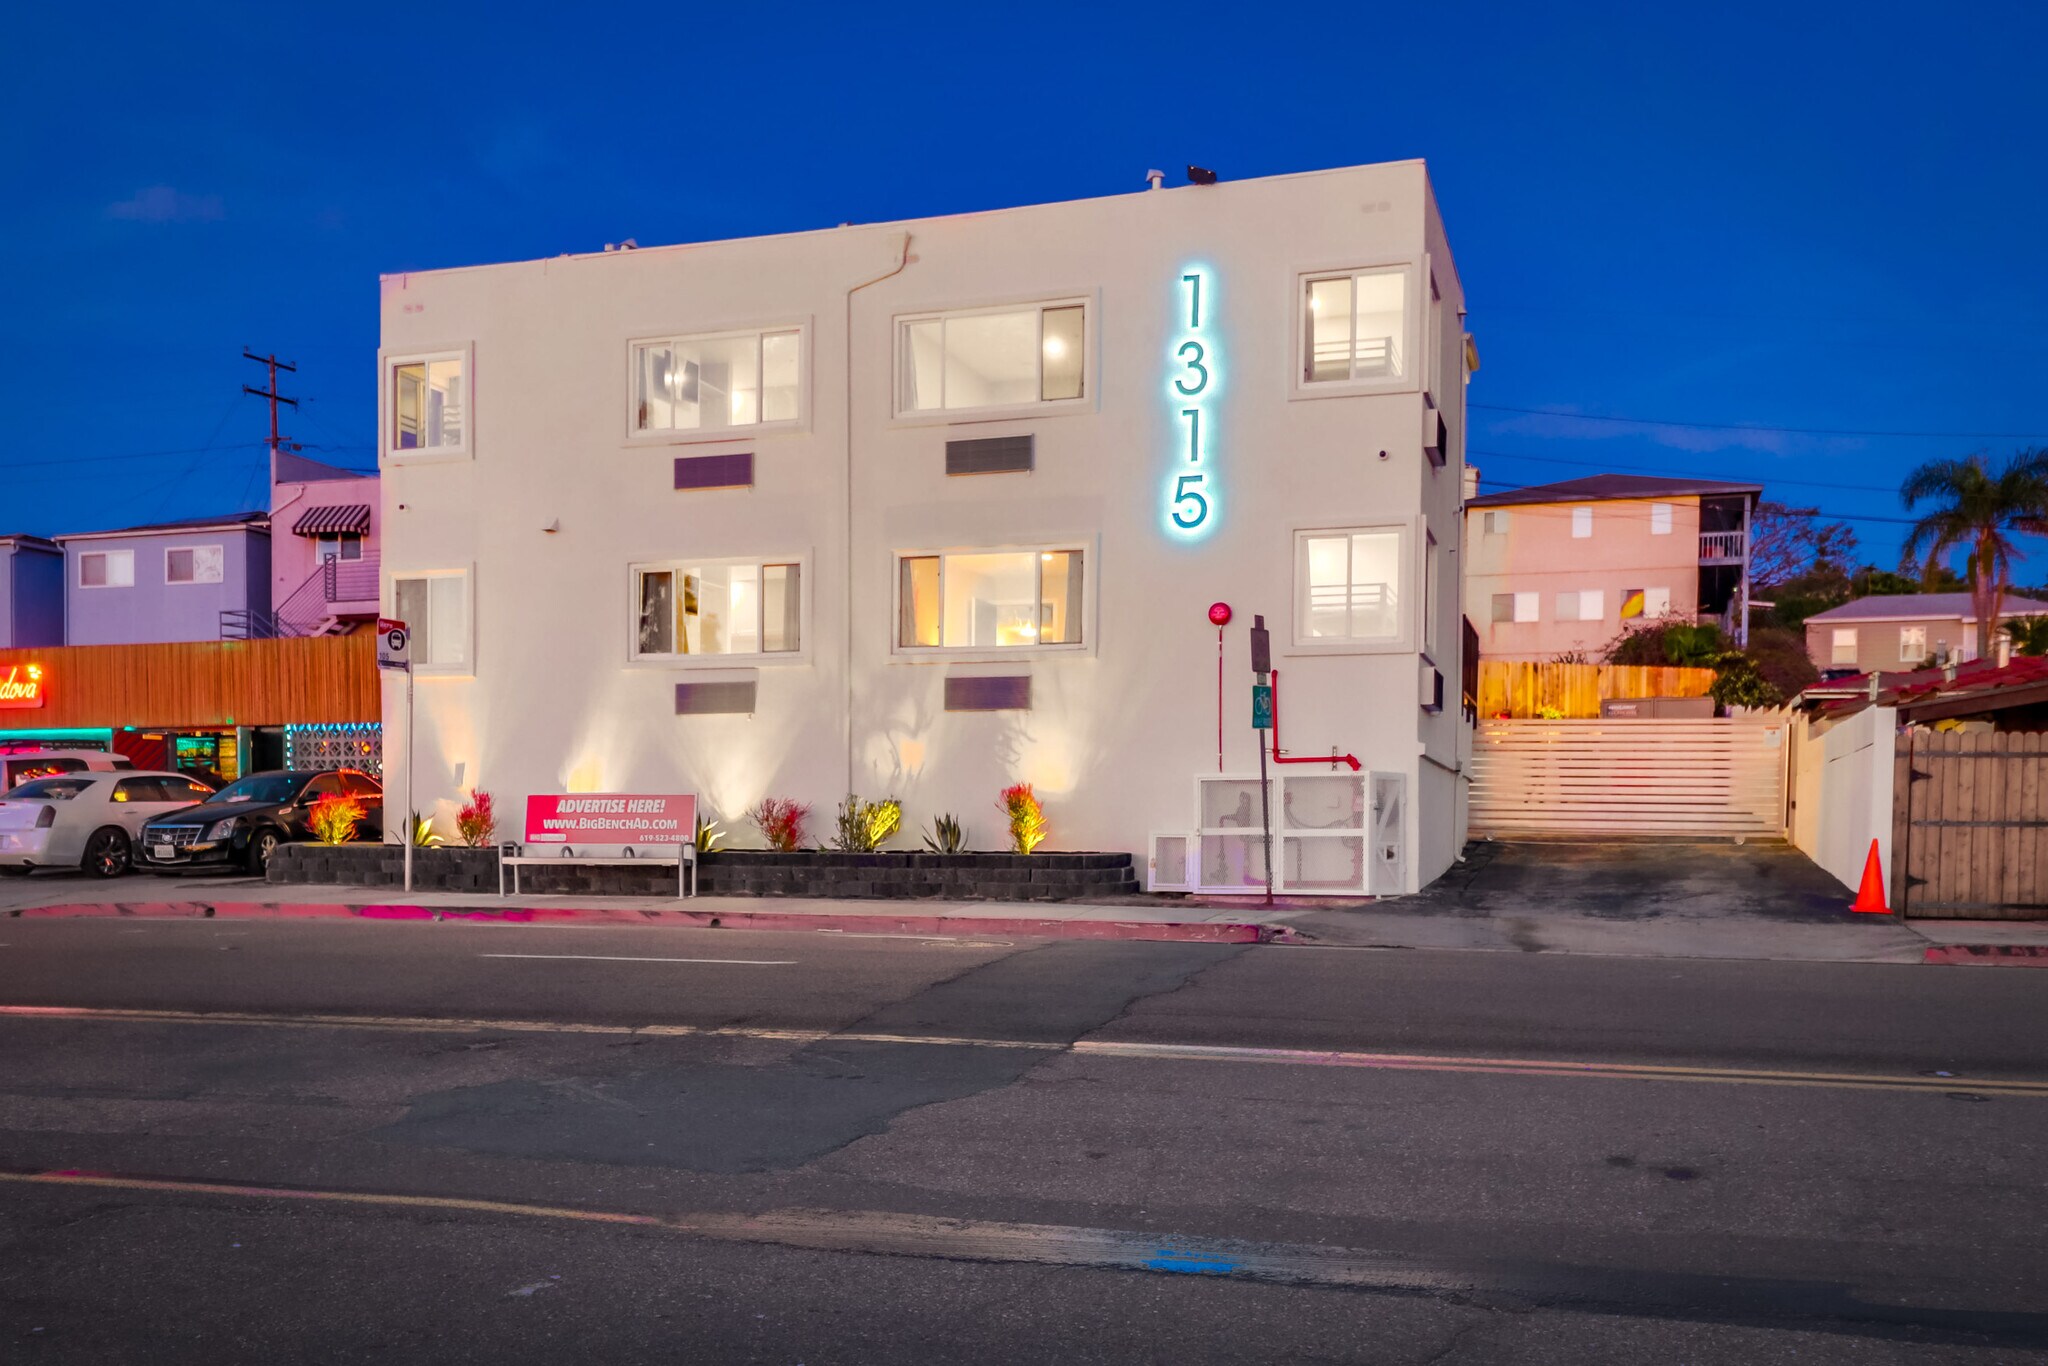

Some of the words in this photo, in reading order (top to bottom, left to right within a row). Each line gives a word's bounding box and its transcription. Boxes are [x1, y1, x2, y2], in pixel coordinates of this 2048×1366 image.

[1171, 274, 1208, 529] 1315
[556, 799, 626, 813] ADVERTISE
[627, 799, 666, 813] HERE!
[639, 834, 690, 842] 619-523-4800
